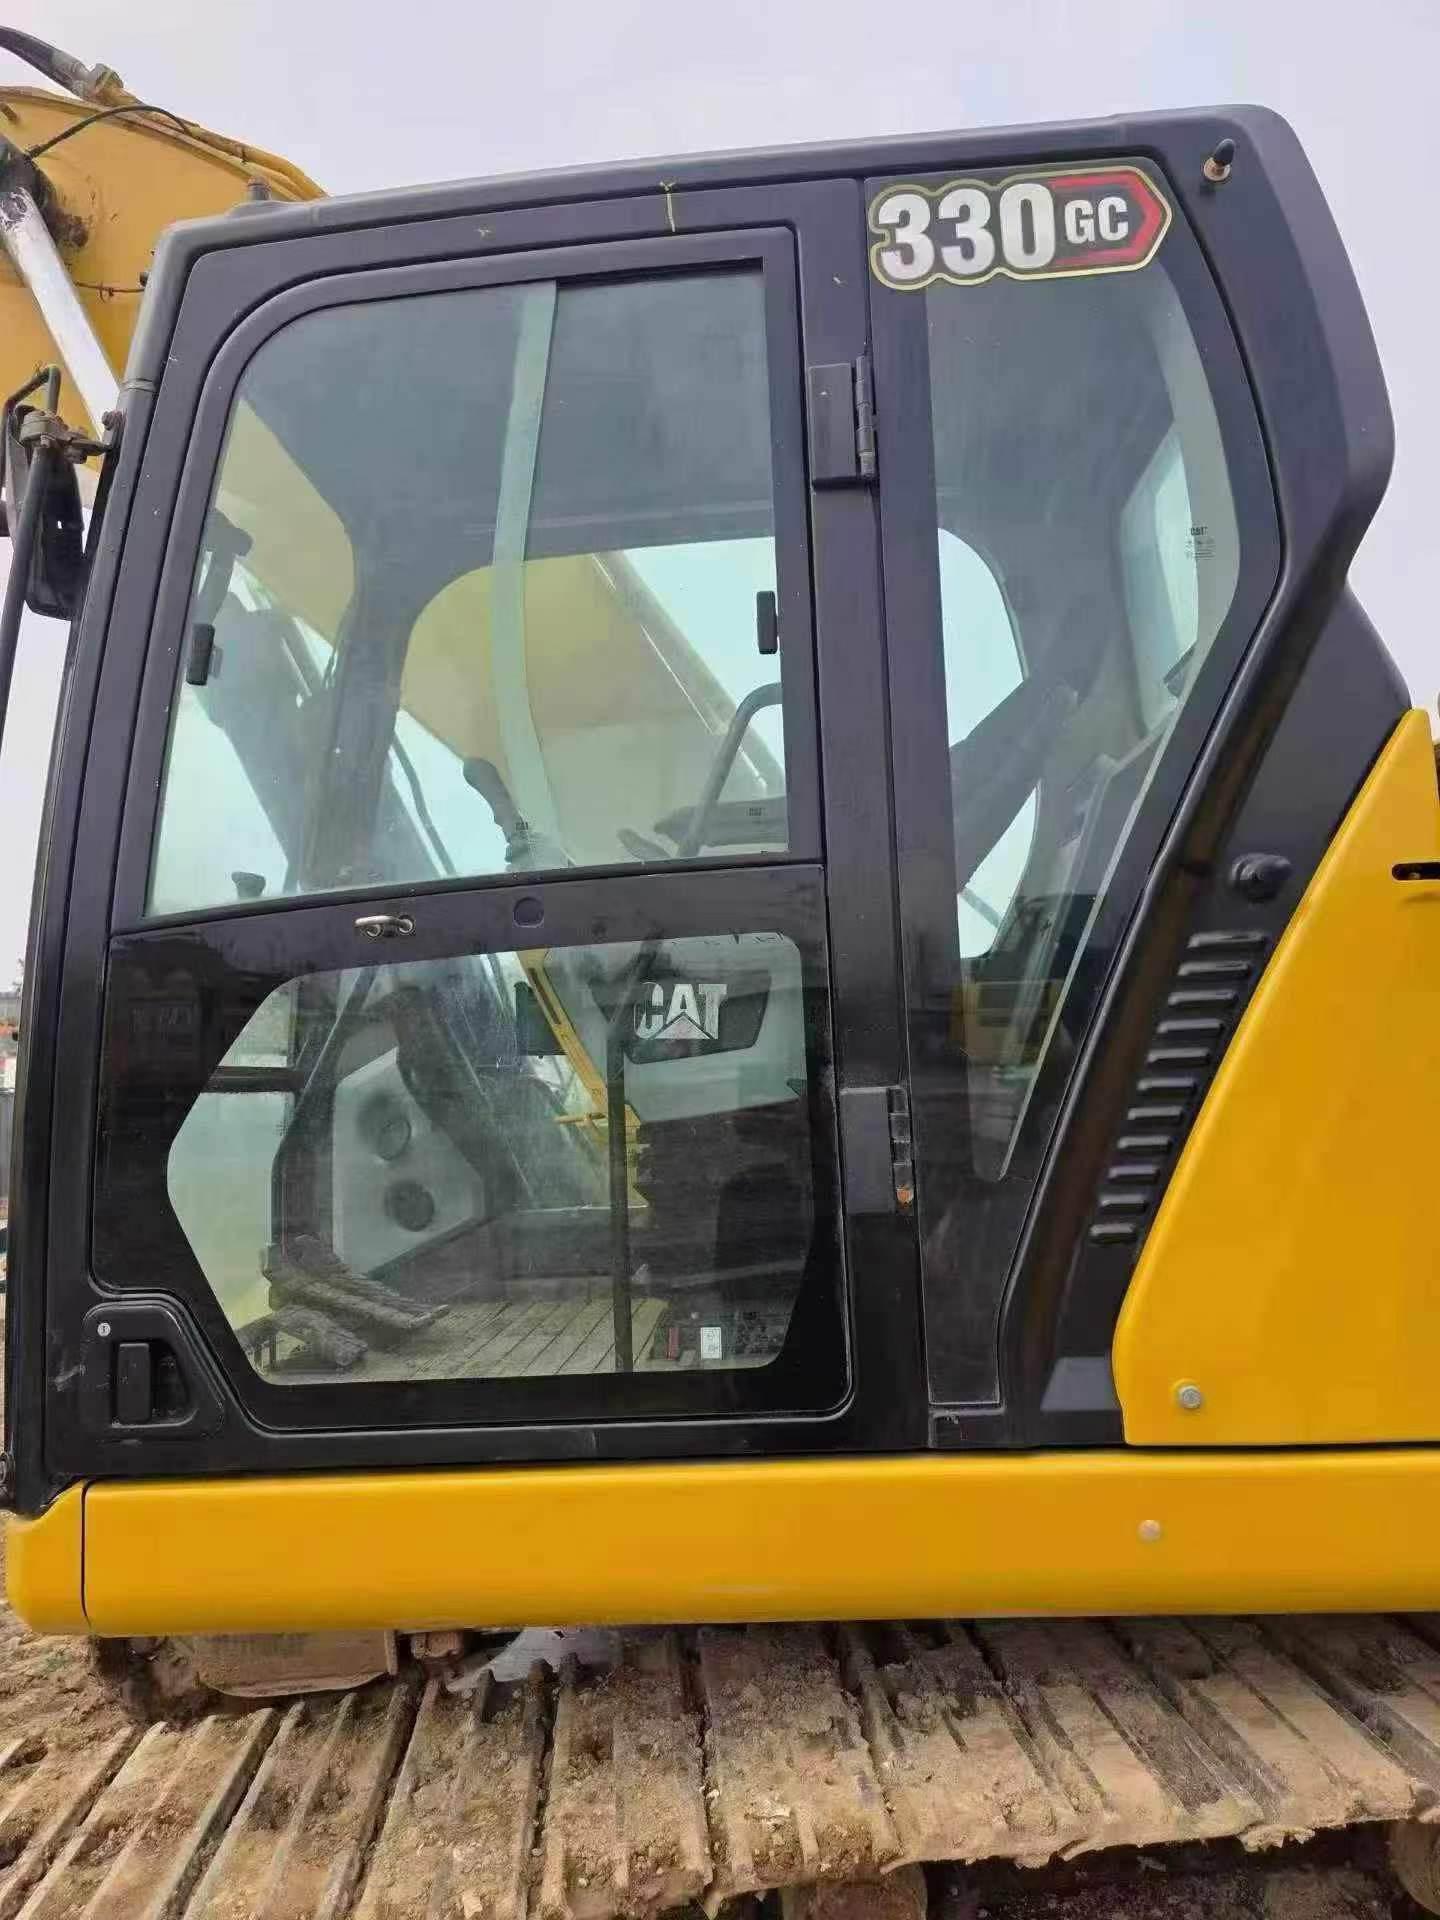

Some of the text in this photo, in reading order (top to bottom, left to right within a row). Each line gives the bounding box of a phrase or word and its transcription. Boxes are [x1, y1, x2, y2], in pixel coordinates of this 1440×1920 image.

[878, 183, 1128, 280] 330 GC
[634, 981, 728, 1040] CAT
